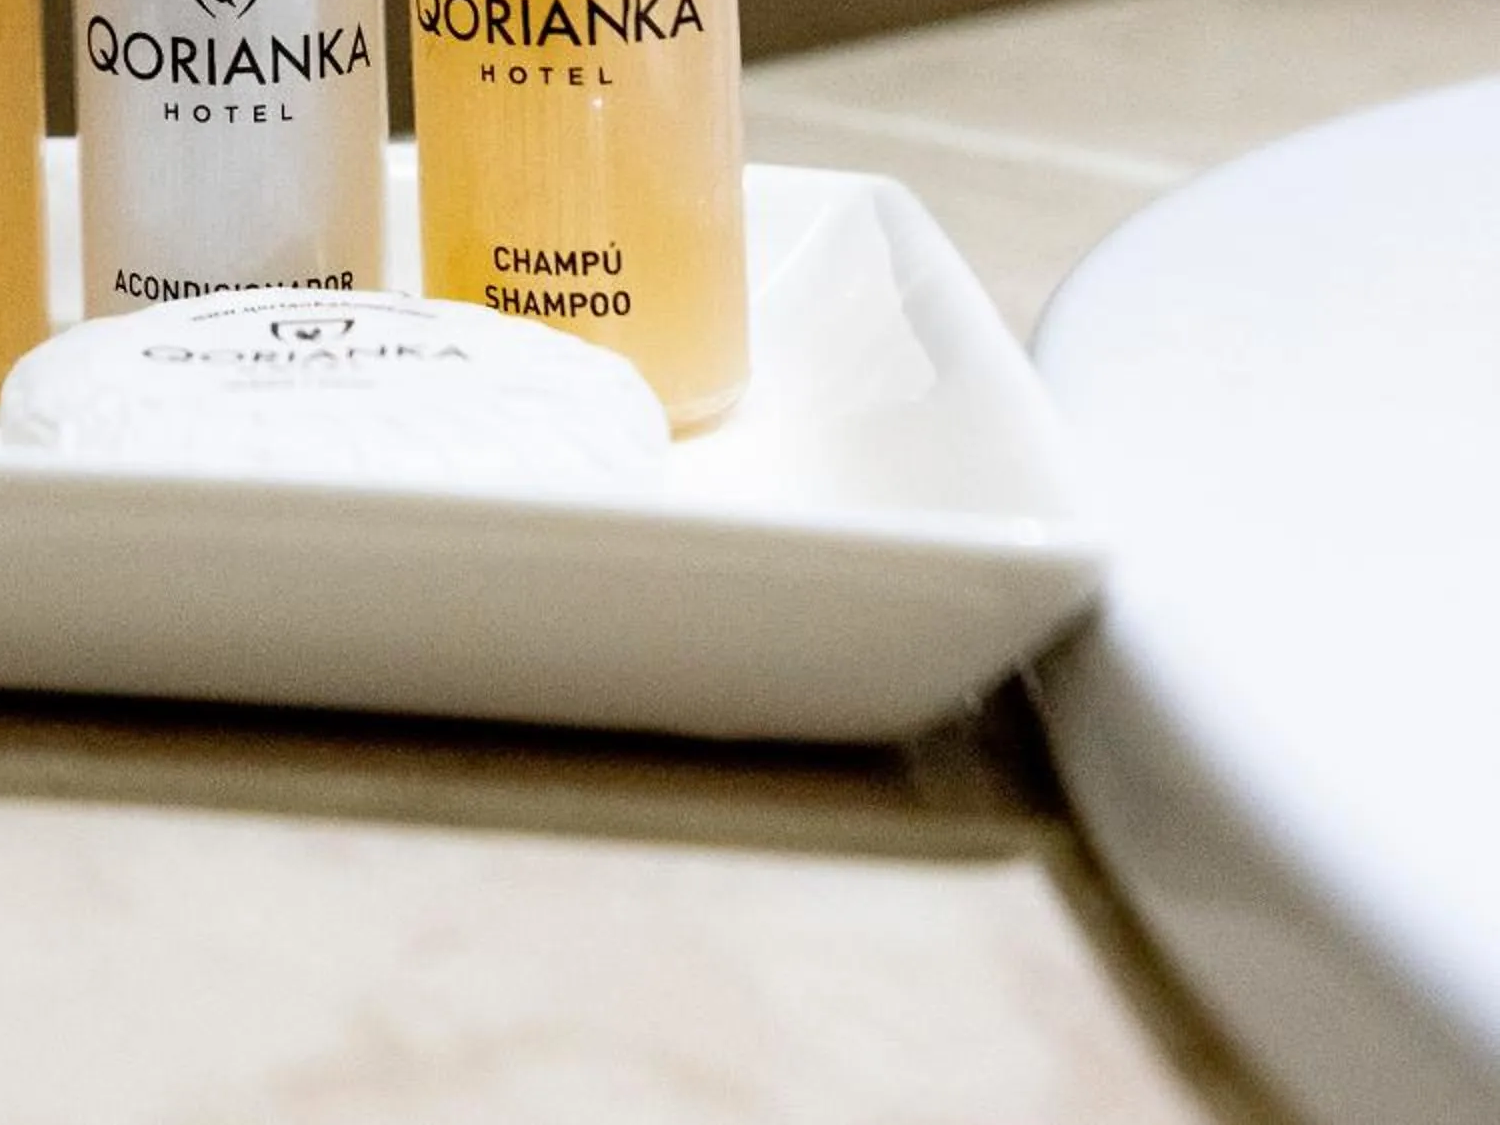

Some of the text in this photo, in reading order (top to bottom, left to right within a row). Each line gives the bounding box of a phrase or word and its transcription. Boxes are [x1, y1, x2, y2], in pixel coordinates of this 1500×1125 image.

[87, 14, 371, 86] QORIANKA
[480, 64, 613, 86] HOTEL
[163, 102, 294, 124] HOTEL
[493, 241, 623, 276] CHAMPÚ
[485, 284, 632, 318] SHAMPOO
